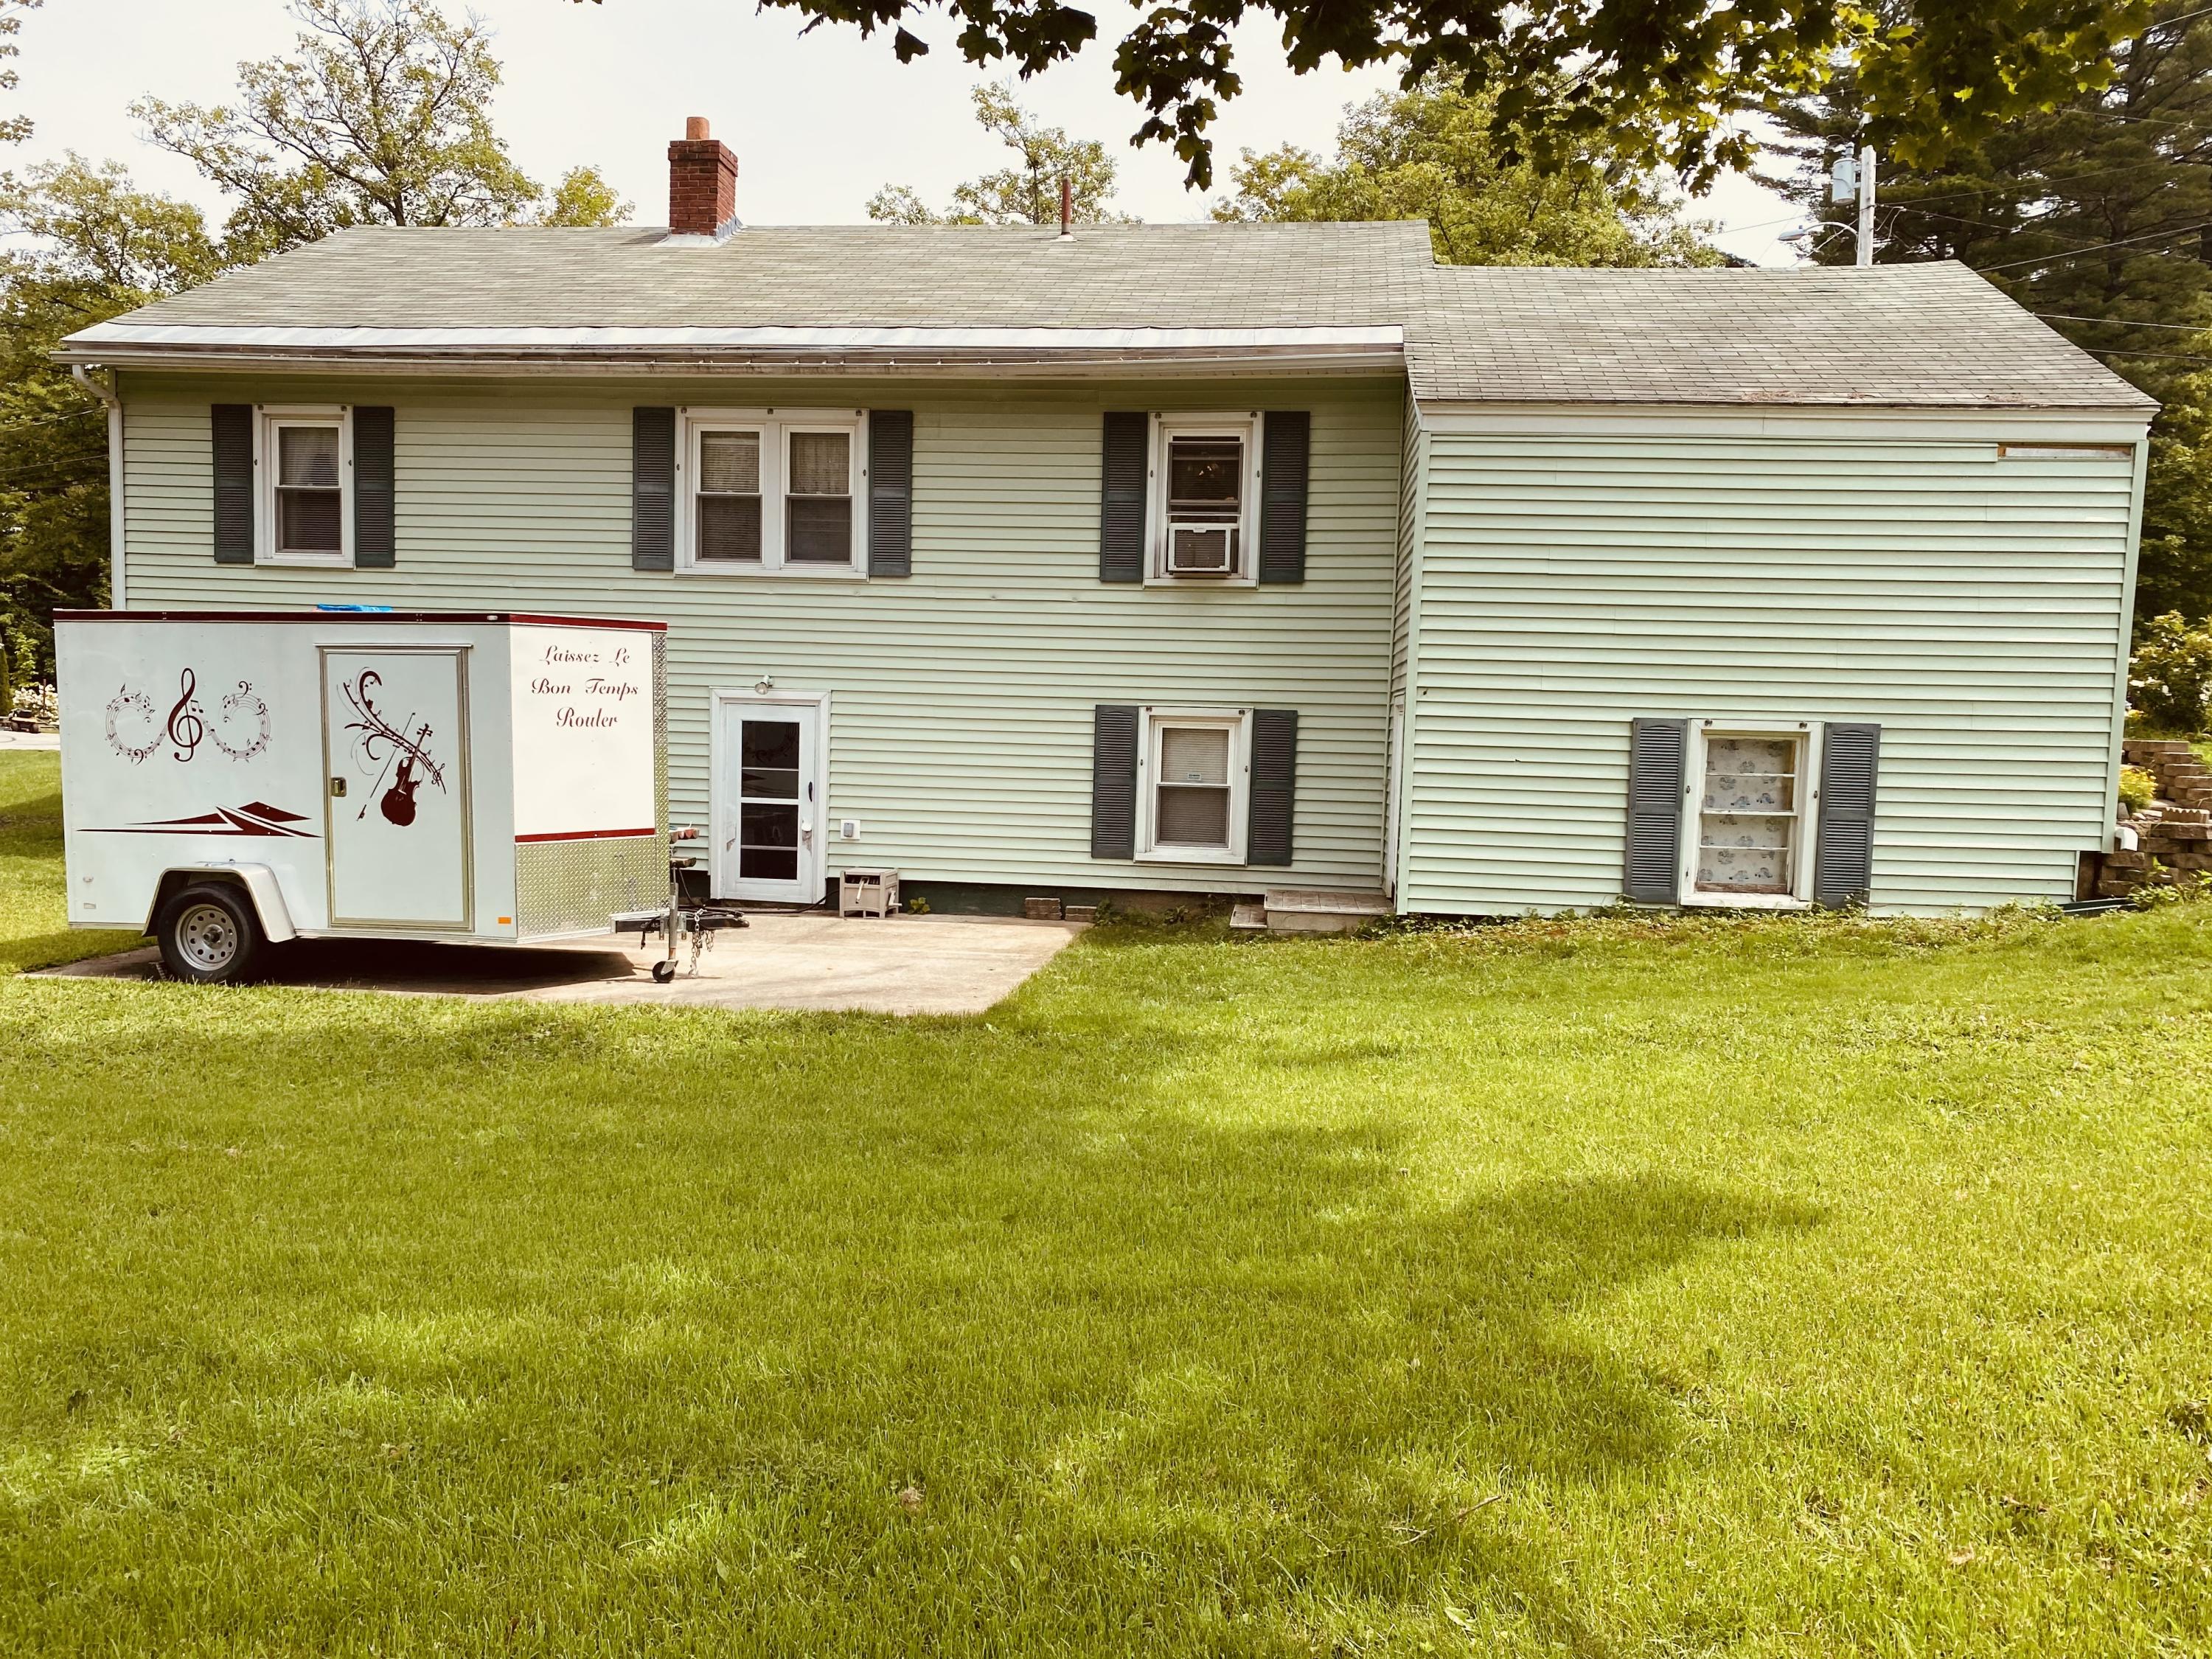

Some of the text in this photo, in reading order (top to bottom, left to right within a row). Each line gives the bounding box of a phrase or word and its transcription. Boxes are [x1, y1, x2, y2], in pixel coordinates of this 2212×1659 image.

[539, 644, 630, 667] Laissez Le
[531, 677, 639, 701] Bon Temps
[556, 706, 619, 728] Rouler
